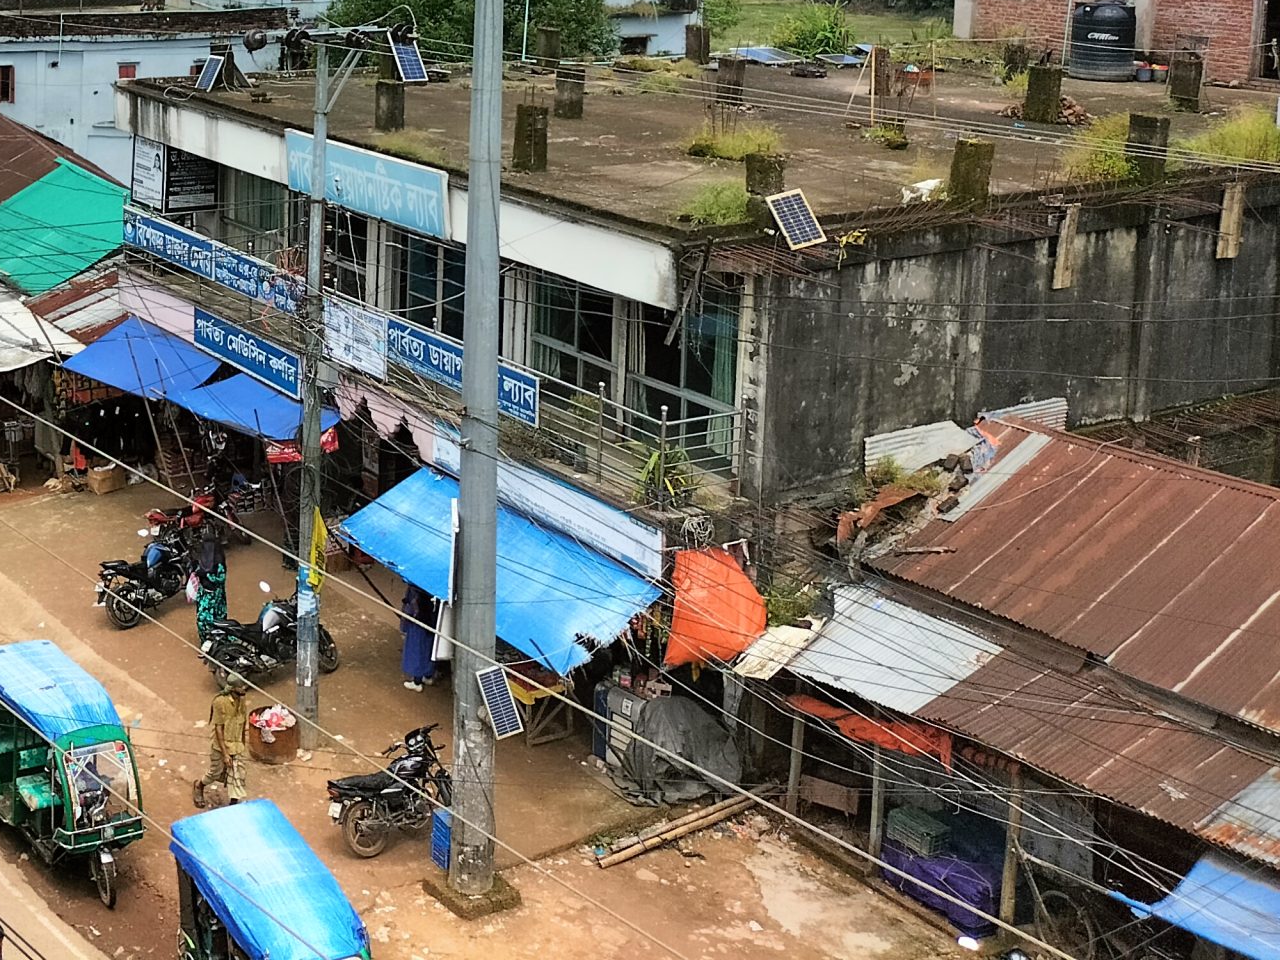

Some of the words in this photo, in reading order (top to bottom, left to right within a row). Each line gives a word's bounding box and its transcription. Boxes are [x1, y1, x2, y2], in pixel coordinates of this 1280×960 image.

[404, 182, 440, 233] ল্যাব
[196, 318, 225, 346] পার্বত্য
[227, 333, 267, 368] মেডিসিন
[388, 327, 426, 361] পার্বত্য
[502, 375, 536, 410] ল্যাব
